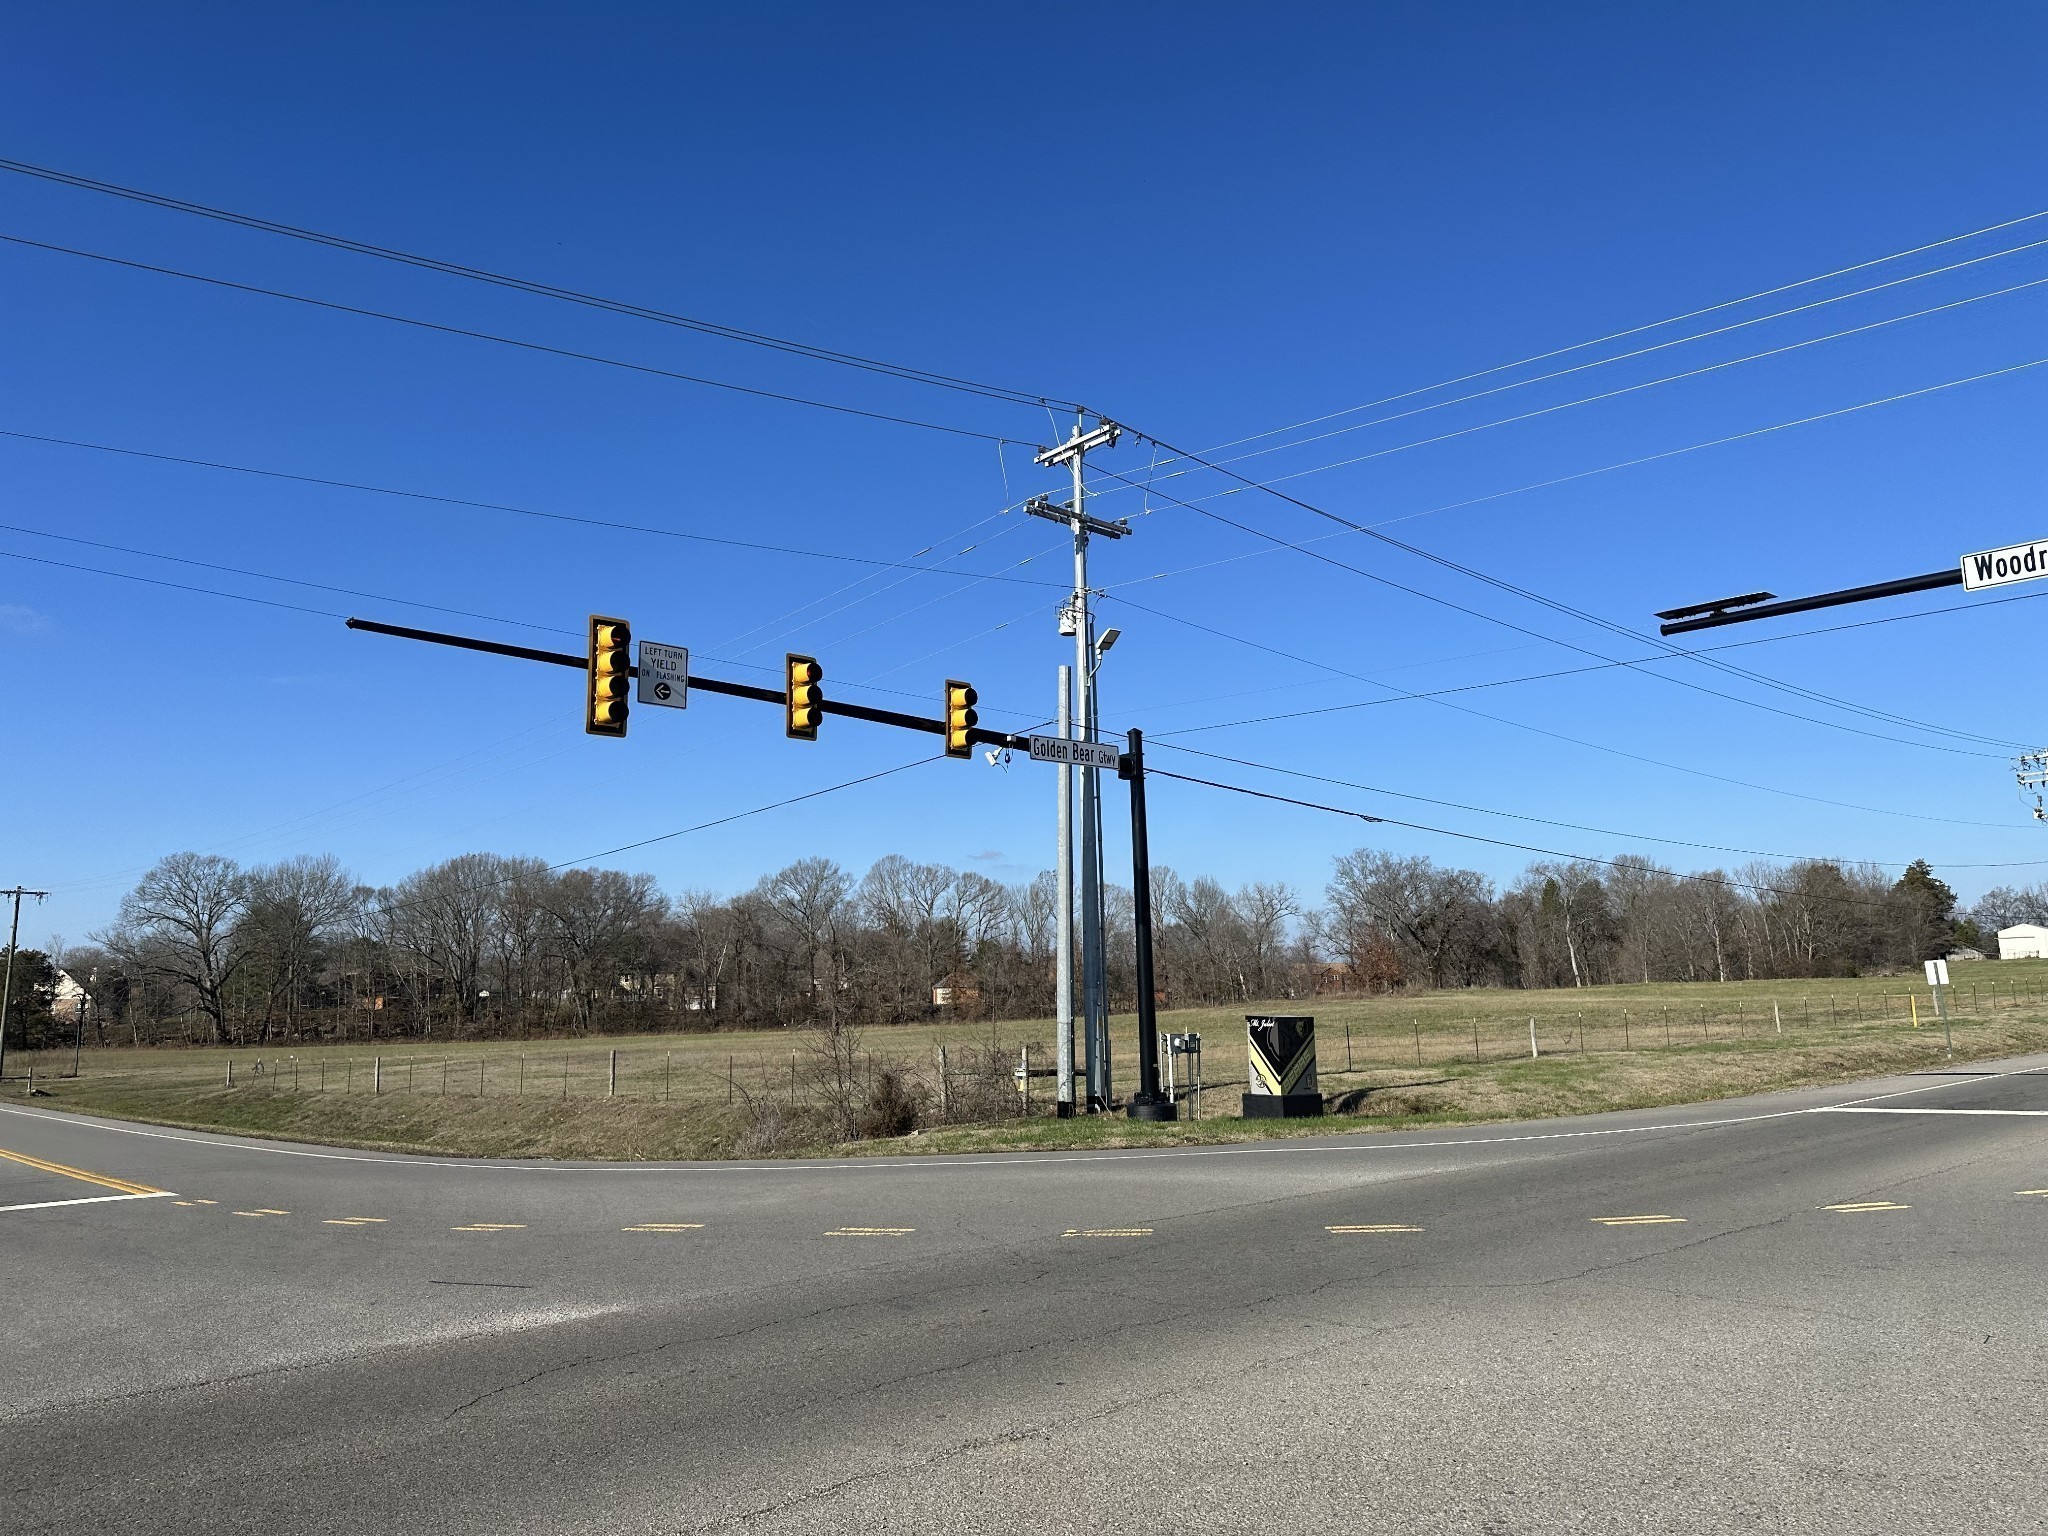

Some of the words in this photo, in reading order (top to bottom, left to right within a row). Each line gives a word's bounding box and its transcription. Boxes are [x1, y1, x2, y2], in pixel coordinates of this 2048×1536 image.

[1973, 545, 2048, 581] Woodr
[644, 646, 662, 656] LEFT
[664, 649, 683, 660] TURN
[650, 657, 677, 671] YIELD
[641, 668, 651, 677] ON
[656, 671, 685, 683] FLASHING
[1033, 737, 1068, 760] Golden
[1072, 743, 1095, 763] Bear
[1098, 750, 1116, 767] Gtwy
